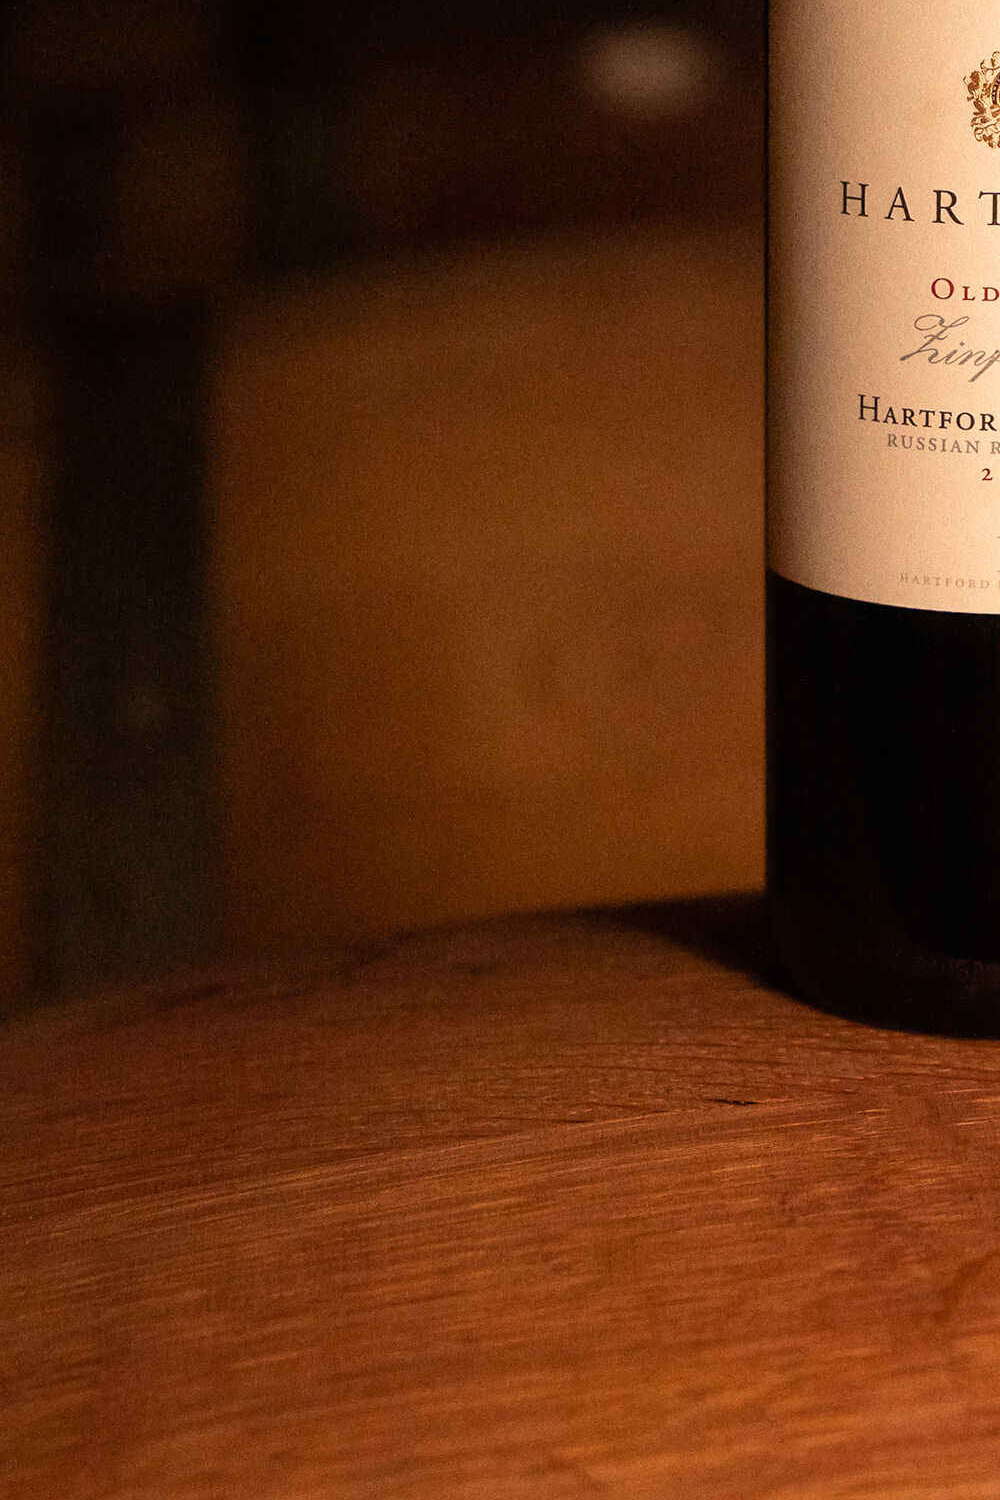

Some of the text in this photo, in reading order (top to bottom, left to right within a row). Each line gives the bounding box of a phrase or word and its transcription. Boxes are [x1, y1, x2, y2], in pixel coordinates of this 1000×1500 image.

[930, 277, 1000, 302] OLD
[887, 433, 980, 454] RUSSIAN
[900, 573, 990, 589] HARTFORD
